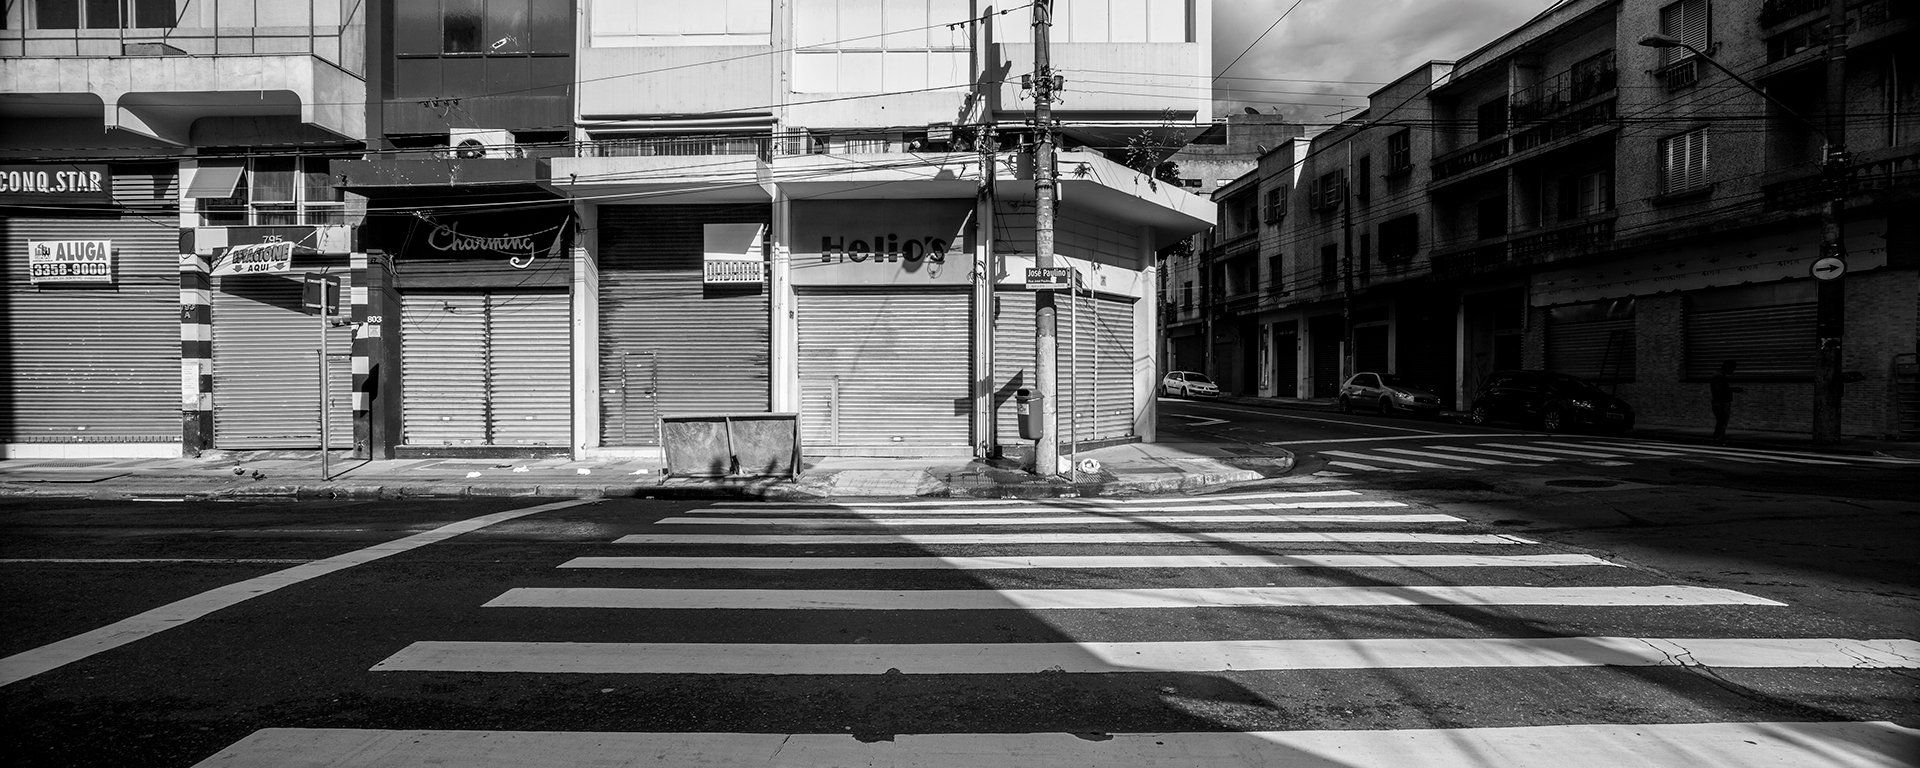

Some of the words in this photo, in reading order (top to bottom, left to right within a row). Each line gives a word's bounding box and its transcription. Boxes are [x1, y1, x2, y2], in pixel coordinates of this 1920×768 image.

[0, 171, 102, 193] CONQ.STAR
[262, 235, 283, 244] 795
[428, 221, 535, 268] Charming
[56, 242, 107, 261] ALUGA
[232, 244, 290, 264] ESTACIONE
[821, 233, 947, 263] Helio's
[33, 263, 106, 275] 3358-9000
[248, 263, 270, 272] AQUI
[1028, 269, 1041, 277] José
[1043, 269, 1066, 277] Pauo
[367, 315, 383, 323] 803
